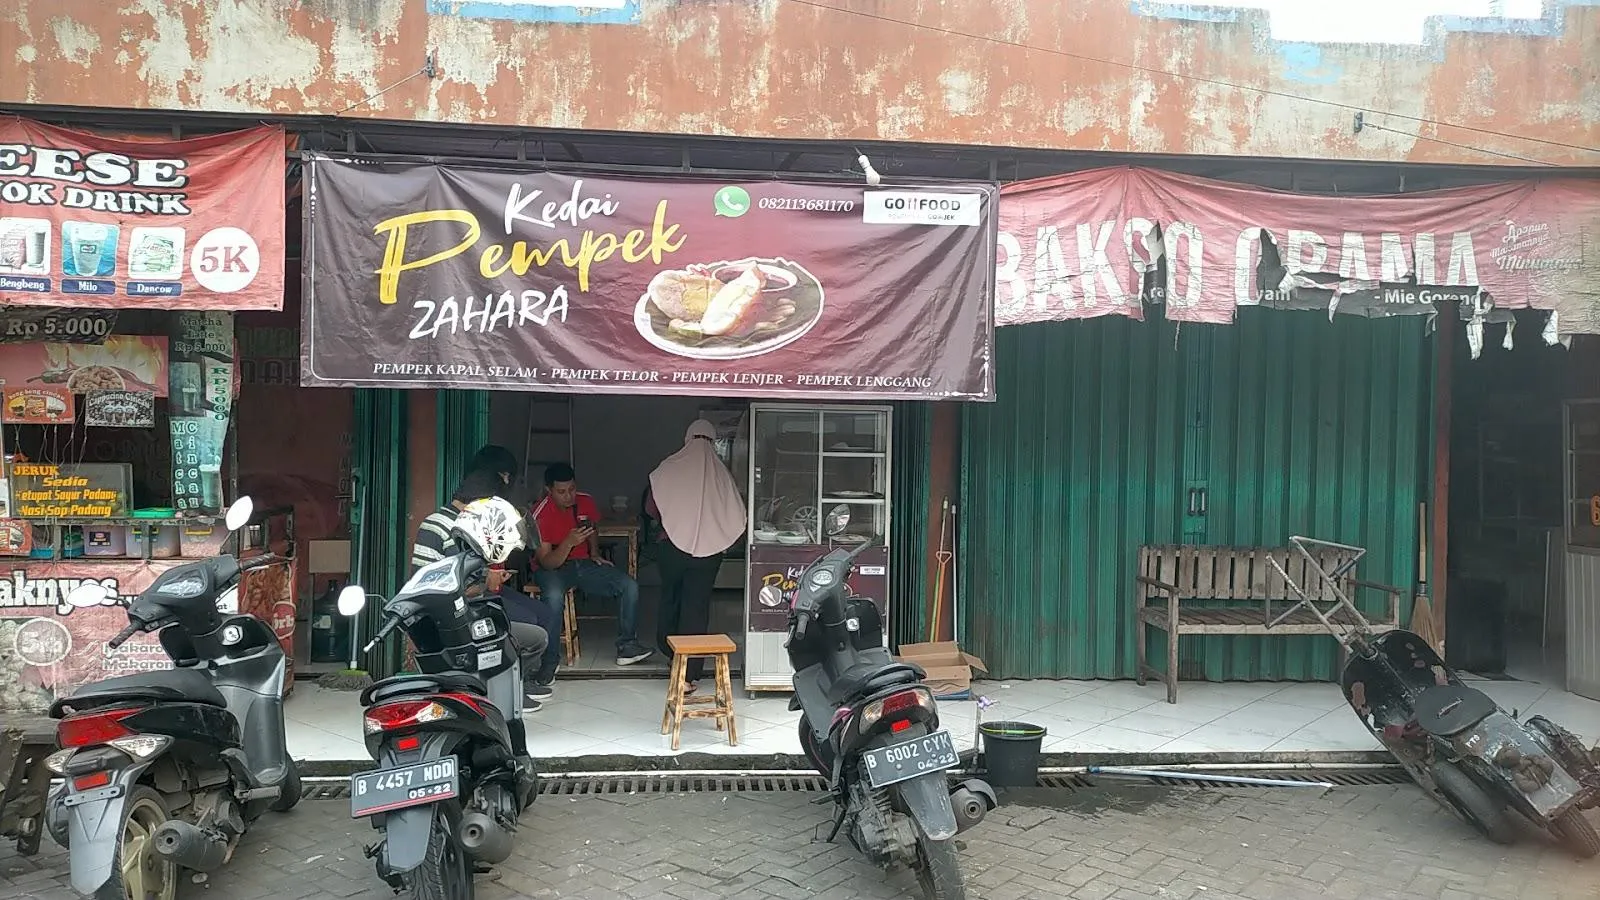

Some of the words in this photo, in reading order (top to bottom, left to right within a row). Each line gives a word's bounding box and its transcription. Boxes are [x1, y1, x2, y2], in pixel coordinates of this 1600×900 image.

[0, 180, 56, 205] OK
[62, 186, 191, 215] DRINK
[504, 179, 620, 235] Kedai
[758, 197, 854, 212] 082113681170
[200, 246, 250, 274] 5K
[373, 199, 688, 305] Pempek
[0, 277, 46, 291] Bengbeng
[78, 280, 98, 292] Milo
[136, 283, 173, 295] Dancow
[1384, 289, 1415, 304] Mie
[408, 284, 570, 340] ZAHARA
[6, 318, 39, 339] Rp
[44, 316, 108, 336] 5.000
[373, 363, 434, 376] PEMPEK
[436, 364, 484, 377] KAPAL
[487, 366, 538, 379] SELAM
[551, 368, 610, 381] PEMPEK
[614, 370, 660, 382] TELOR
[671, 371, 729, 384] PEMPEK
[733, 373, 784, 386] LENJER
[796, 374, 853, 387] PEMPEK
[856, 376, 932, 388] LENGGANG
[14, 465, 60, 476] JERUK
[42, 475, 89, 487] Sedia
[16, 489, 52, 502] etupat
[54, 489, 82, 502] Sayur
[21, 504, 46, 516] Nasi
[47, 504, 69, 518] Sop
[70, 503, 112, 518] Padang
[867, 754, 877, 768] B
[885, 743, 920, 763] 6002
[923, 733, 951, 753] CYK
[358, 779, 367, 796] B
[376, 770, 413, 791] 4457
[424, 762, 452, 782] NDD
